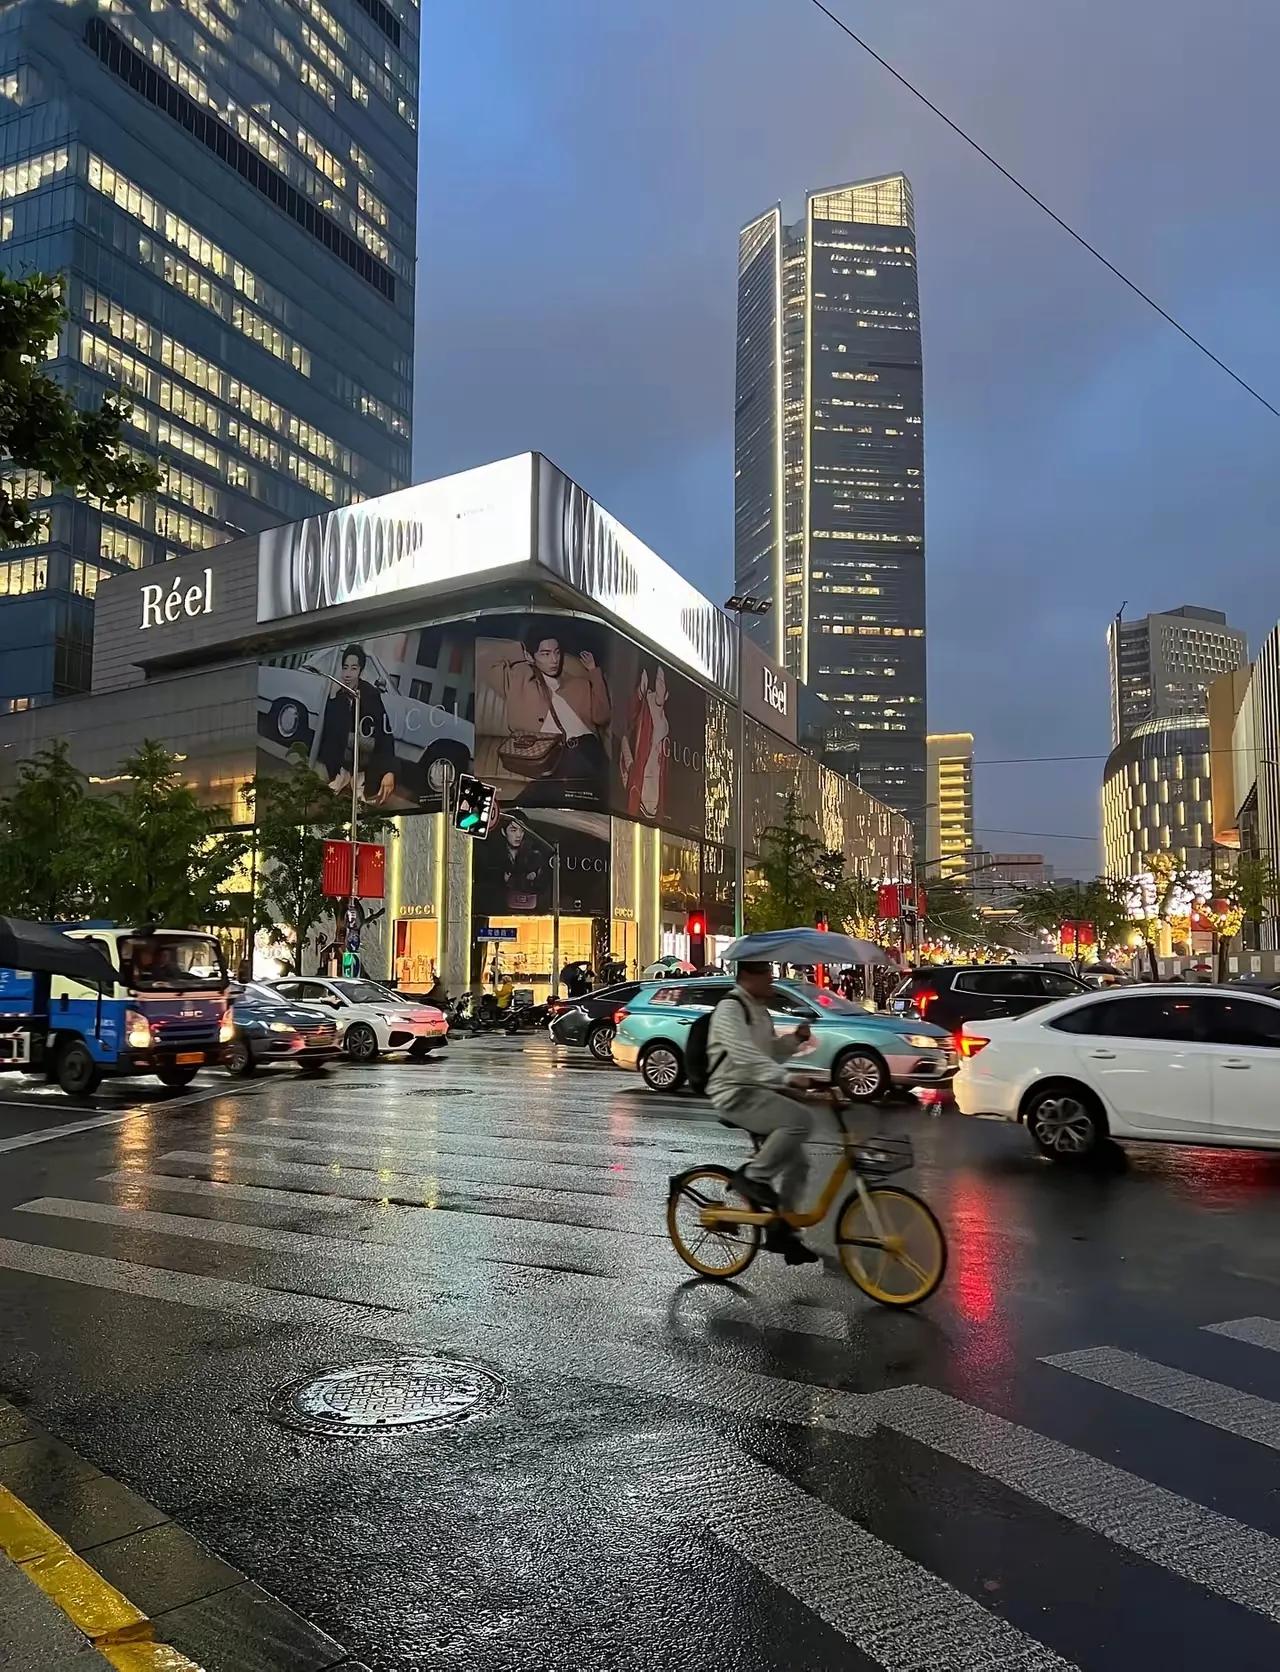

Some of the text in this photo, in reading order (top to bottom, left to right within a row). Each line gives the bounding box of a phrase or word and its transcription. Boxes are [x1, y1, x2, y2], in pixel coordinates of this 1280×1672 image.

[139, 568, 213, 630] Réel
[763, 666, 787, 716] Réel
[360, 702, 458, 738] GUCCI
[662, 736, 705, 774] GUCCI
[399, 904, 435, 916] GUCCI
